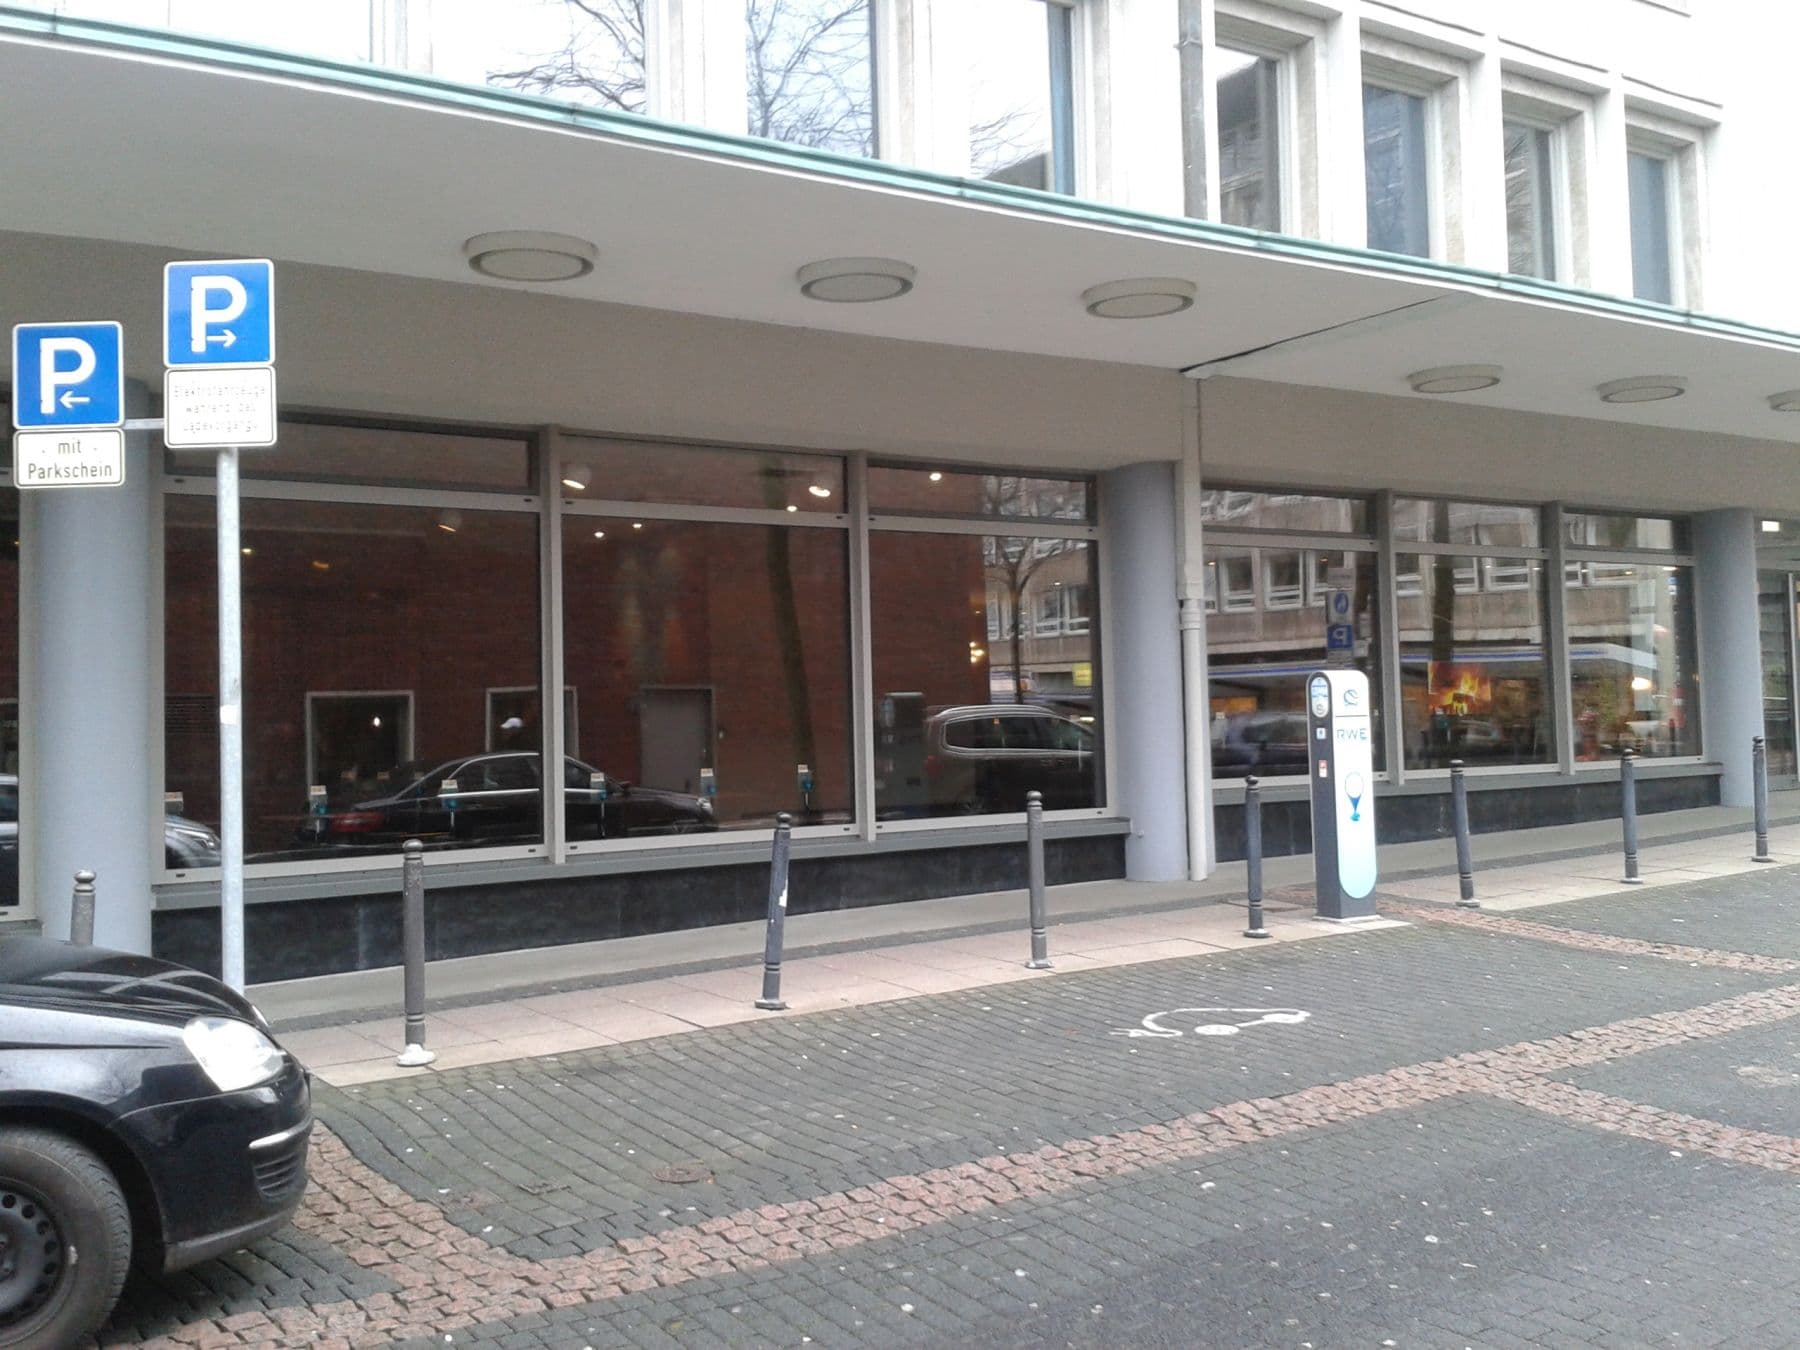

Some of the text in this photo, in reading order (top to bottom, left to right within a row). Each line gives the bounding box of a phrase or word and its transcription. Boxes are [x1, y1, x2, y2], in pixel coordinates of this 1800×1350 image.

[191, 275, 247, 353] P
[40, 337, 96, 415] P
[58, 438, 82, 454] mit
[28, 461, 112, 480] Parkschein
[1337, 728, 1368, 742] RWE
